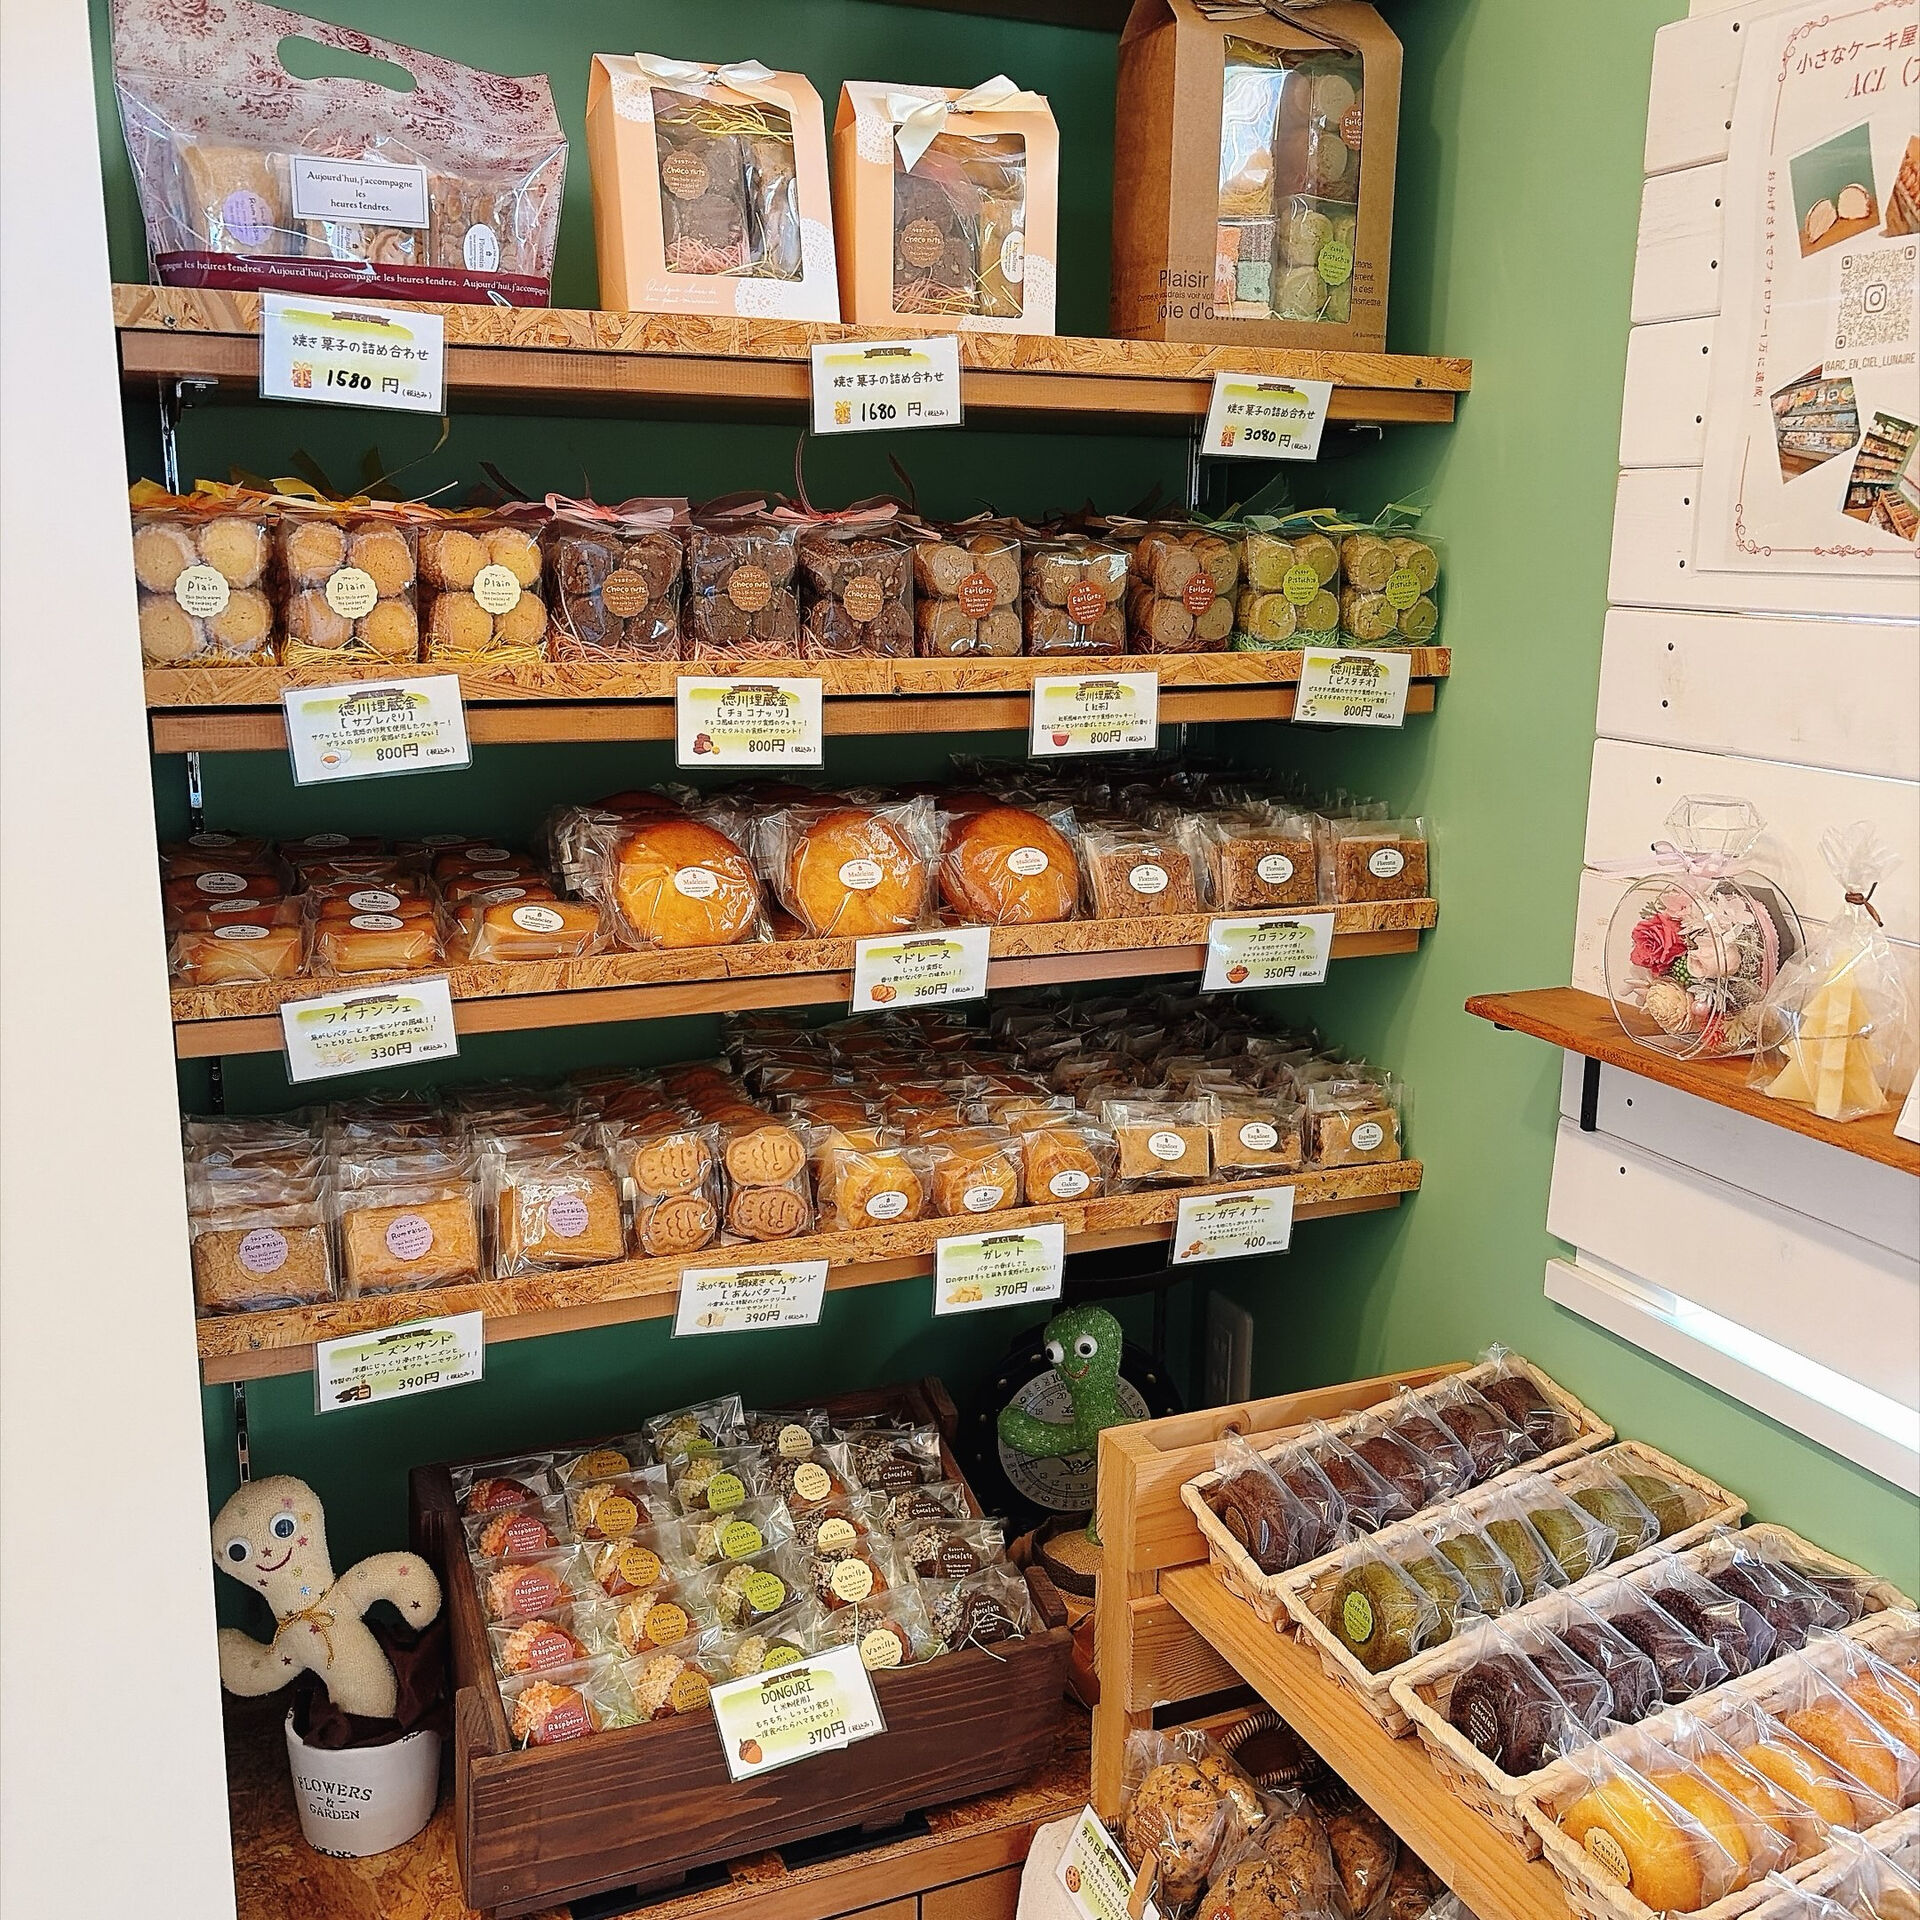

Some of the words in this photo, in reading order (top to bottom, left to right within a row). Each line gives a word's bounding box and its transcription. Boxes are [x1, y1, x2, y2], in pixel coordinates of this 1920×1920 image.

[1796, 24, 1918, 75] 小さなケーキ屋
[355, 189, 366, 198] les
[331, 198, 357, 209] heures
[358, 200, 392, 212] tendres.
[184, 260, 195, 269] les
[197, 260, 227, 271] heures
[383, 273, 395, 282] les
[396, 275, 424, 284] heures
[1159, 269, 1209, 288] Plaisir
[1157, 301, 1184, 323] joie
[292, 333, 429, 361] 焼き菓子の詰め合わせ
[327, 369, 372, 390] 1580
[382, 377, 399, 394] 円
[833, 371, 944, 388] 焼き菓子の詰め合わせ
[861, 402, 897, 422] 1680
[907, 402, 921, 417] 円
[1227, 402, 1316, 420] 焼き菓子の詰め合わせ
[1244, 428, 1276, 442] 3080
[1278, 434, 1292, 447] 円
[187, 581, 218, 592] Plain
[337, 582, 366, 593] Plain
[484, 578, 511, 588] Plain
[606, 585, 629, 593] Choco
[630, 585, 646, 593] nuts
[1330, 663, 1383, 678] 徳川埋蔵金
[721, 693, 790, 708] 徳川埋蔵金
[1075, 689, 1123, 702] 徳川埋蔵金
[338, 696, 418, 717] 徳川埋蔵金
[717, 708, 789, 718] 【チョコナッツ】
[1343, 705, 1373, 718] 800円
[1090, 729, 1122, 744] 800円
[376, 743, 419, 761] 800円
[748, 738, 785, 753] 800円
[1249, 931, 1307, 943] フロランタン
[893, 950, 951, 964] マドレーヌ
[1264, 966, 1296, 978] 350円
[914, 983, 948, 997] 360円
[324, 1003, 412, 1024] フィナンシェ
[370, 1041, 412, 1060] 330円
[1195, 1205, 1271, 1222] エンガディナー
[1243, 1236, 1266, 1248] 400
[983, 1246, 1024, 1260] ガレット
[722, 1286, 787, 1299] 【あんバター】
[994, 1281, 1028, 1297] 370円
[744, 1310, 781, 1323] 390円
[360, 1335, 454, 1362] レーズンサンド
[398, 1371, 440, 1390] 390円
[783, 1434, 809, 1444] Vanilla
[798, 1471, 824, 1484] Vanilla
[882, 1470, 913, 1480] Chocolate
[911, 1506, 941, 1516] Chocolate
[508, 1526, 541, 1537] Raspberry
[822, 1528, 850, 1541] Vanilla
[942, 1552, 973, 1561] Chocolate
[836, 1568, 866, 1583] Vanilla
[515, 1584, 550, 1596] Raspberry
[971, 1605, 1000, 1617] Chocolate
[531, 1642, 567, 1657] Raspberry
[865, 1640, 895, 1656] Vanilla
[760, 1678, 814, 1705] DONGURI
[548, 1716, 584, 1732] Raspberry
[807, 1720, 846, 1745] 370円
[296, 1776, 374, 1802] FLOWERS
[309, 1803, 360, 1820] GARDEN
